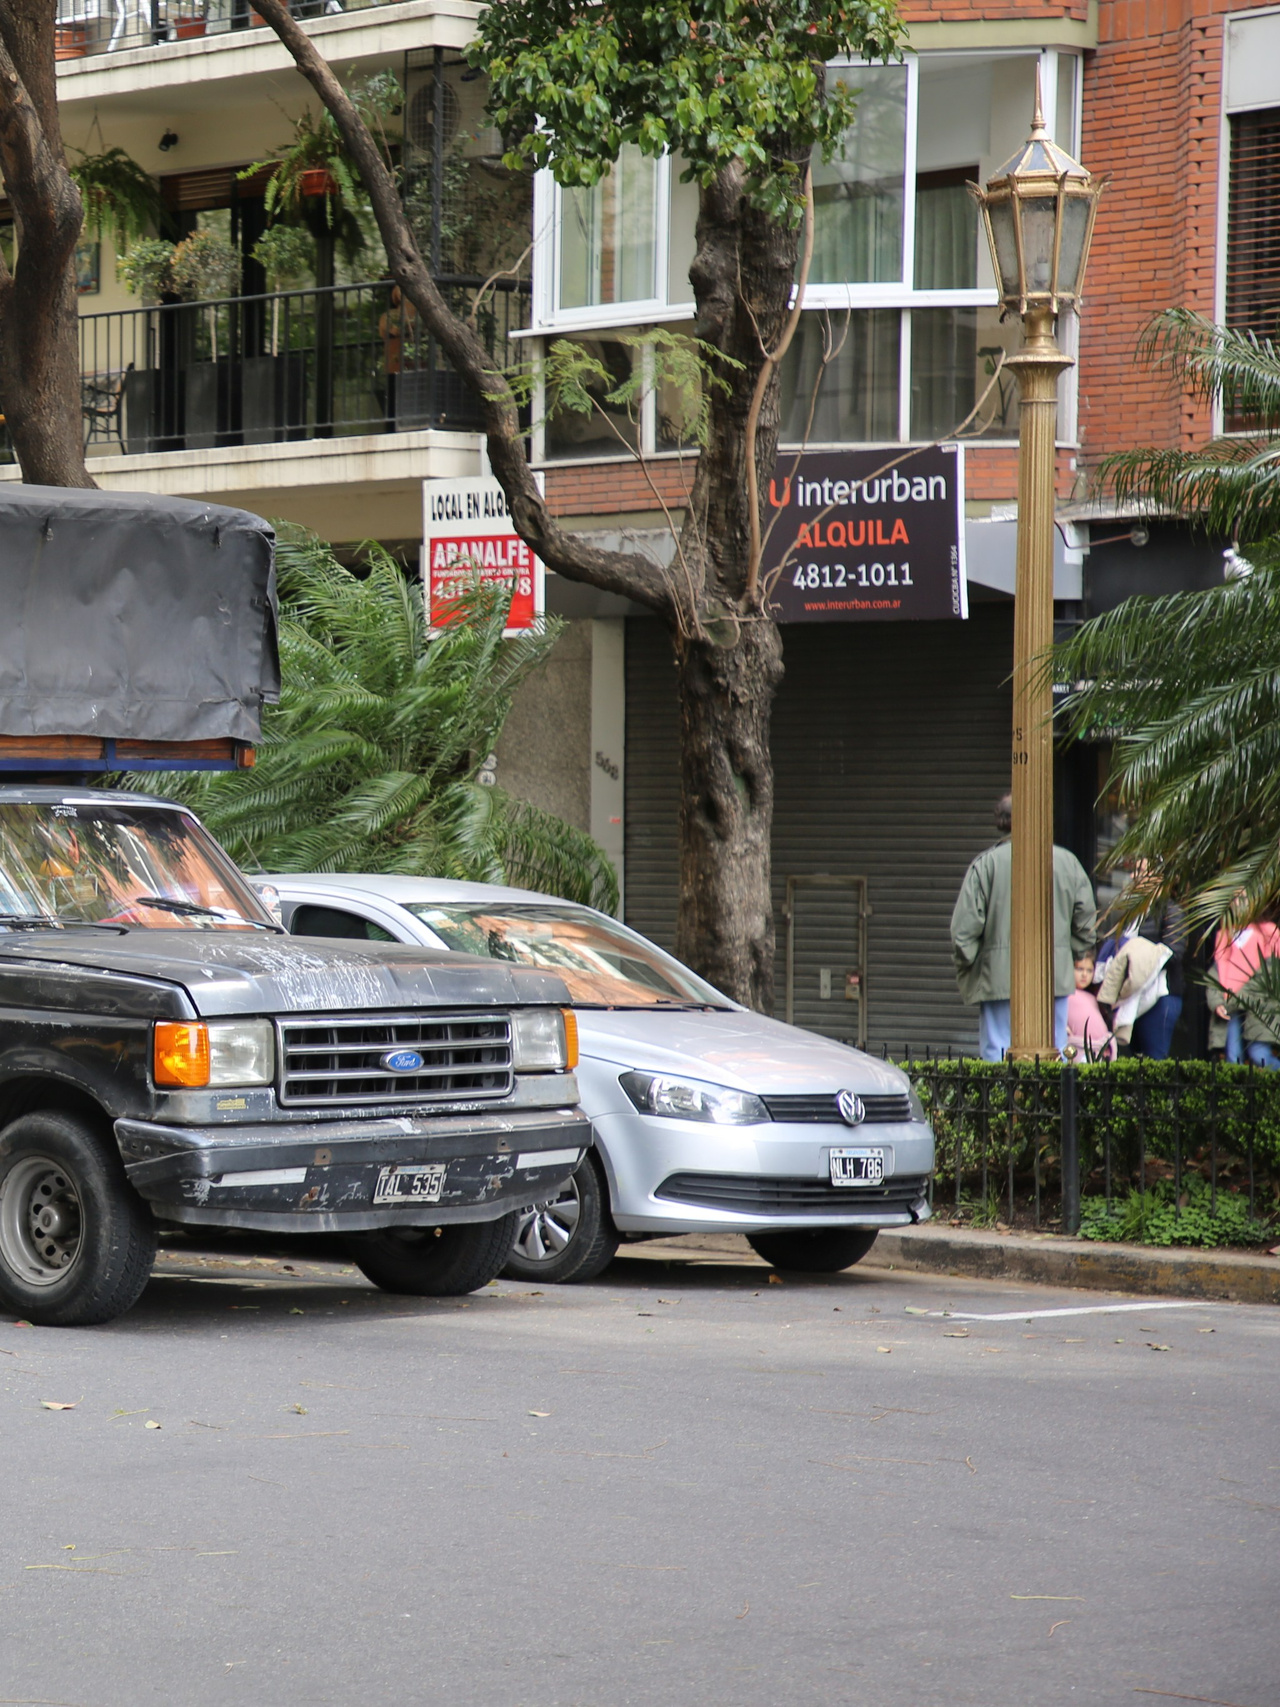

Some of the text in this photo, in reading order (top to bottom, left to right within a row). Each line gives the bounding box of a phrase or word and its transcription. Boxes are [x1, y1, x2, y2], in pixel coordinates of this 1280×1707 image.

[797, 469, 946, 507] interurban
[431, 493, 463, 521] LOCAL
[467, 492, 480, 519] EN
[795, 518, 910, 548] ALQUILA
[792, 562, 914, 590] 4812-1011
[804, 598, 901, 611] www.interurban.com.ar
[832, 1158, 882, 1178] NLH 786
[380, 1173, 440, 1196] TAL 535
